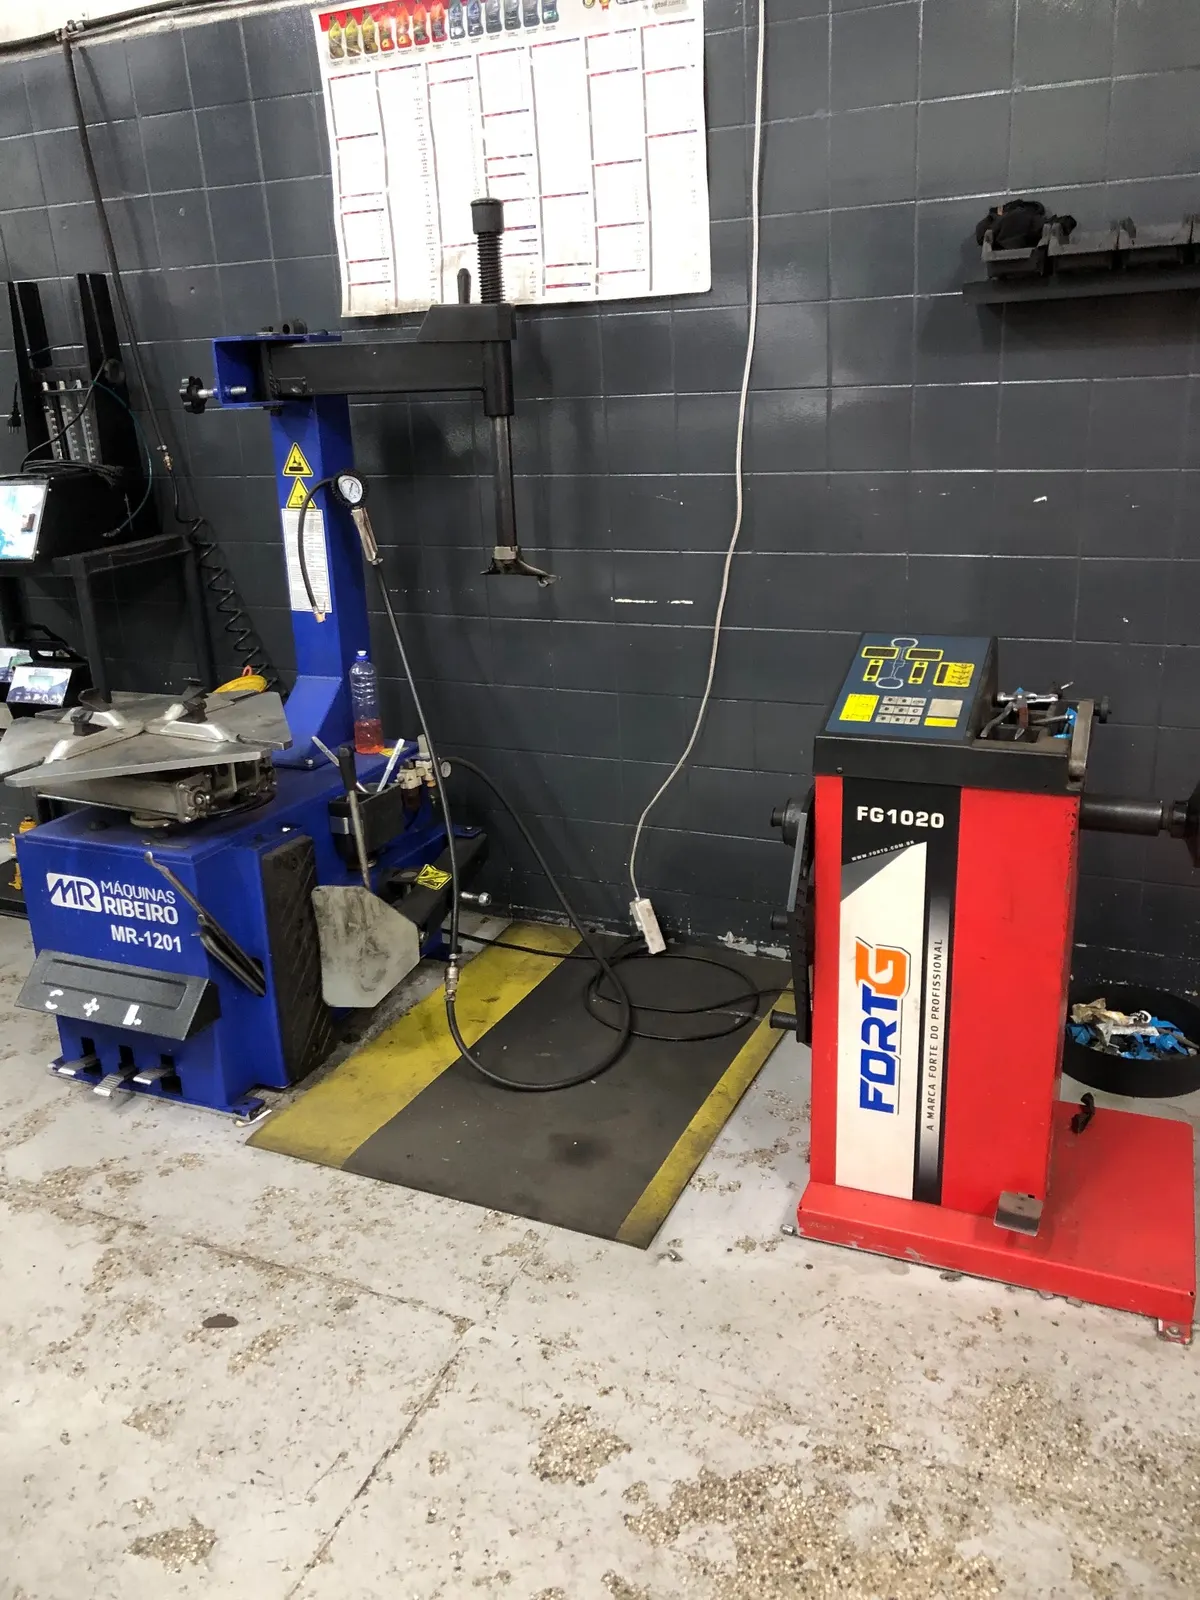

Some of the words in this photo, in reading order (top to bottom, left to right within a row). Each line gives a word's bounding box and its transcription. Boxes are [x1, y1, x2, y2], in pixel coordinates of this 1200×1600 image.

[856, 805, 945, 829] FG1020
[47, 876, 100, 911] MR
[100, 880, 176, 904] MÁQUINAS
[102, 896, 179, 925] RIBEIRO
[110, 924, 182, 953] MR-1201
[930, 939, 943, 1020] PROFISSIONAL
[855, 939, 909, 1114] FORTG
[930, 1025, 939, 1040] DO
[928, 1044, 938, 1078] FORTE
[926, 1083, 936, 1119] MARCA
